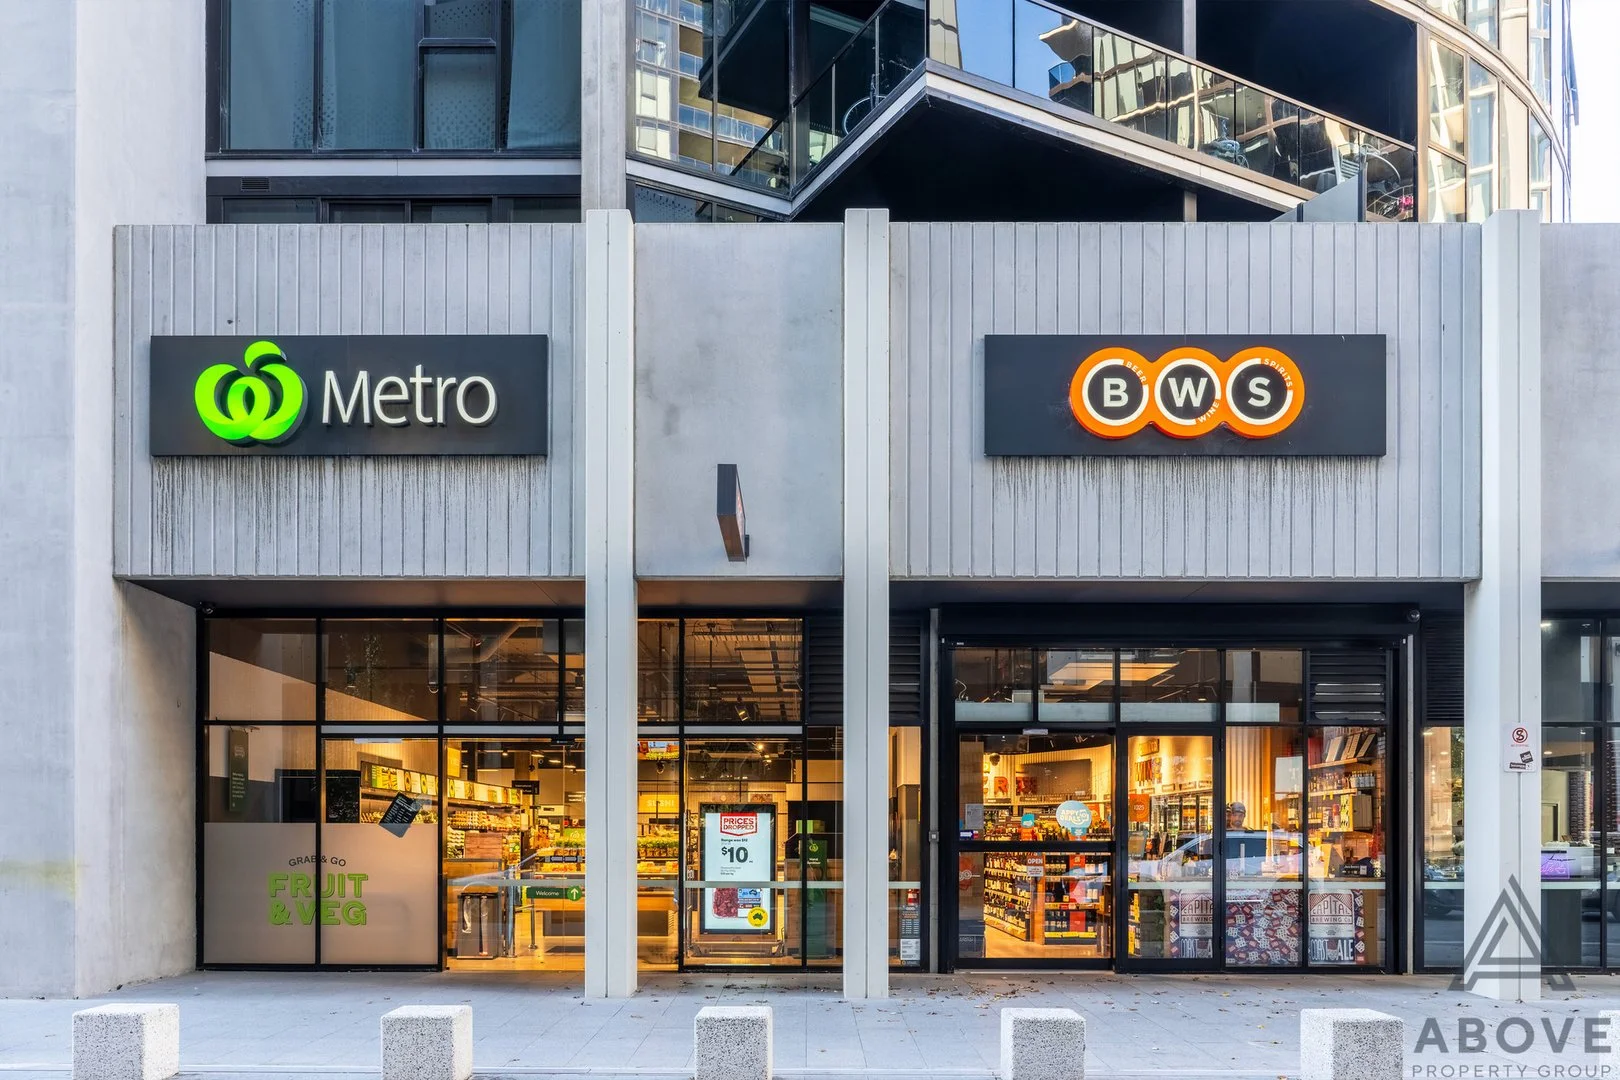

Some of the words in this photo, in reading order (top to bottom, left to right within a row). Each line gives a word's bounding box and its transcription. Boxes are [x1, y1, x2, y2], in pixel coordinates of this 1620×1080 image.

[1126, 361, 1147, 384] BEER
[1263, 358, 1293, 388] SPIRITS
[322, 364, 498, 426] Metro
[1197, 399, 1220, 424] WINE
[723, 817, 755, 825] PRICES
[288, 855, 319, 867] GRAB
[330, 856, 347, 867] GO
[721, 846, 749, 863] $10
[268, 872, 369, 899] FRUIT
[1184, 896, 1213, 914] CAPIT
[1311, 896, 1351, 915] CAPITAL
[1310, 939, 1329, 961] COAST
[1336, 939, 1354, 961] ALE
